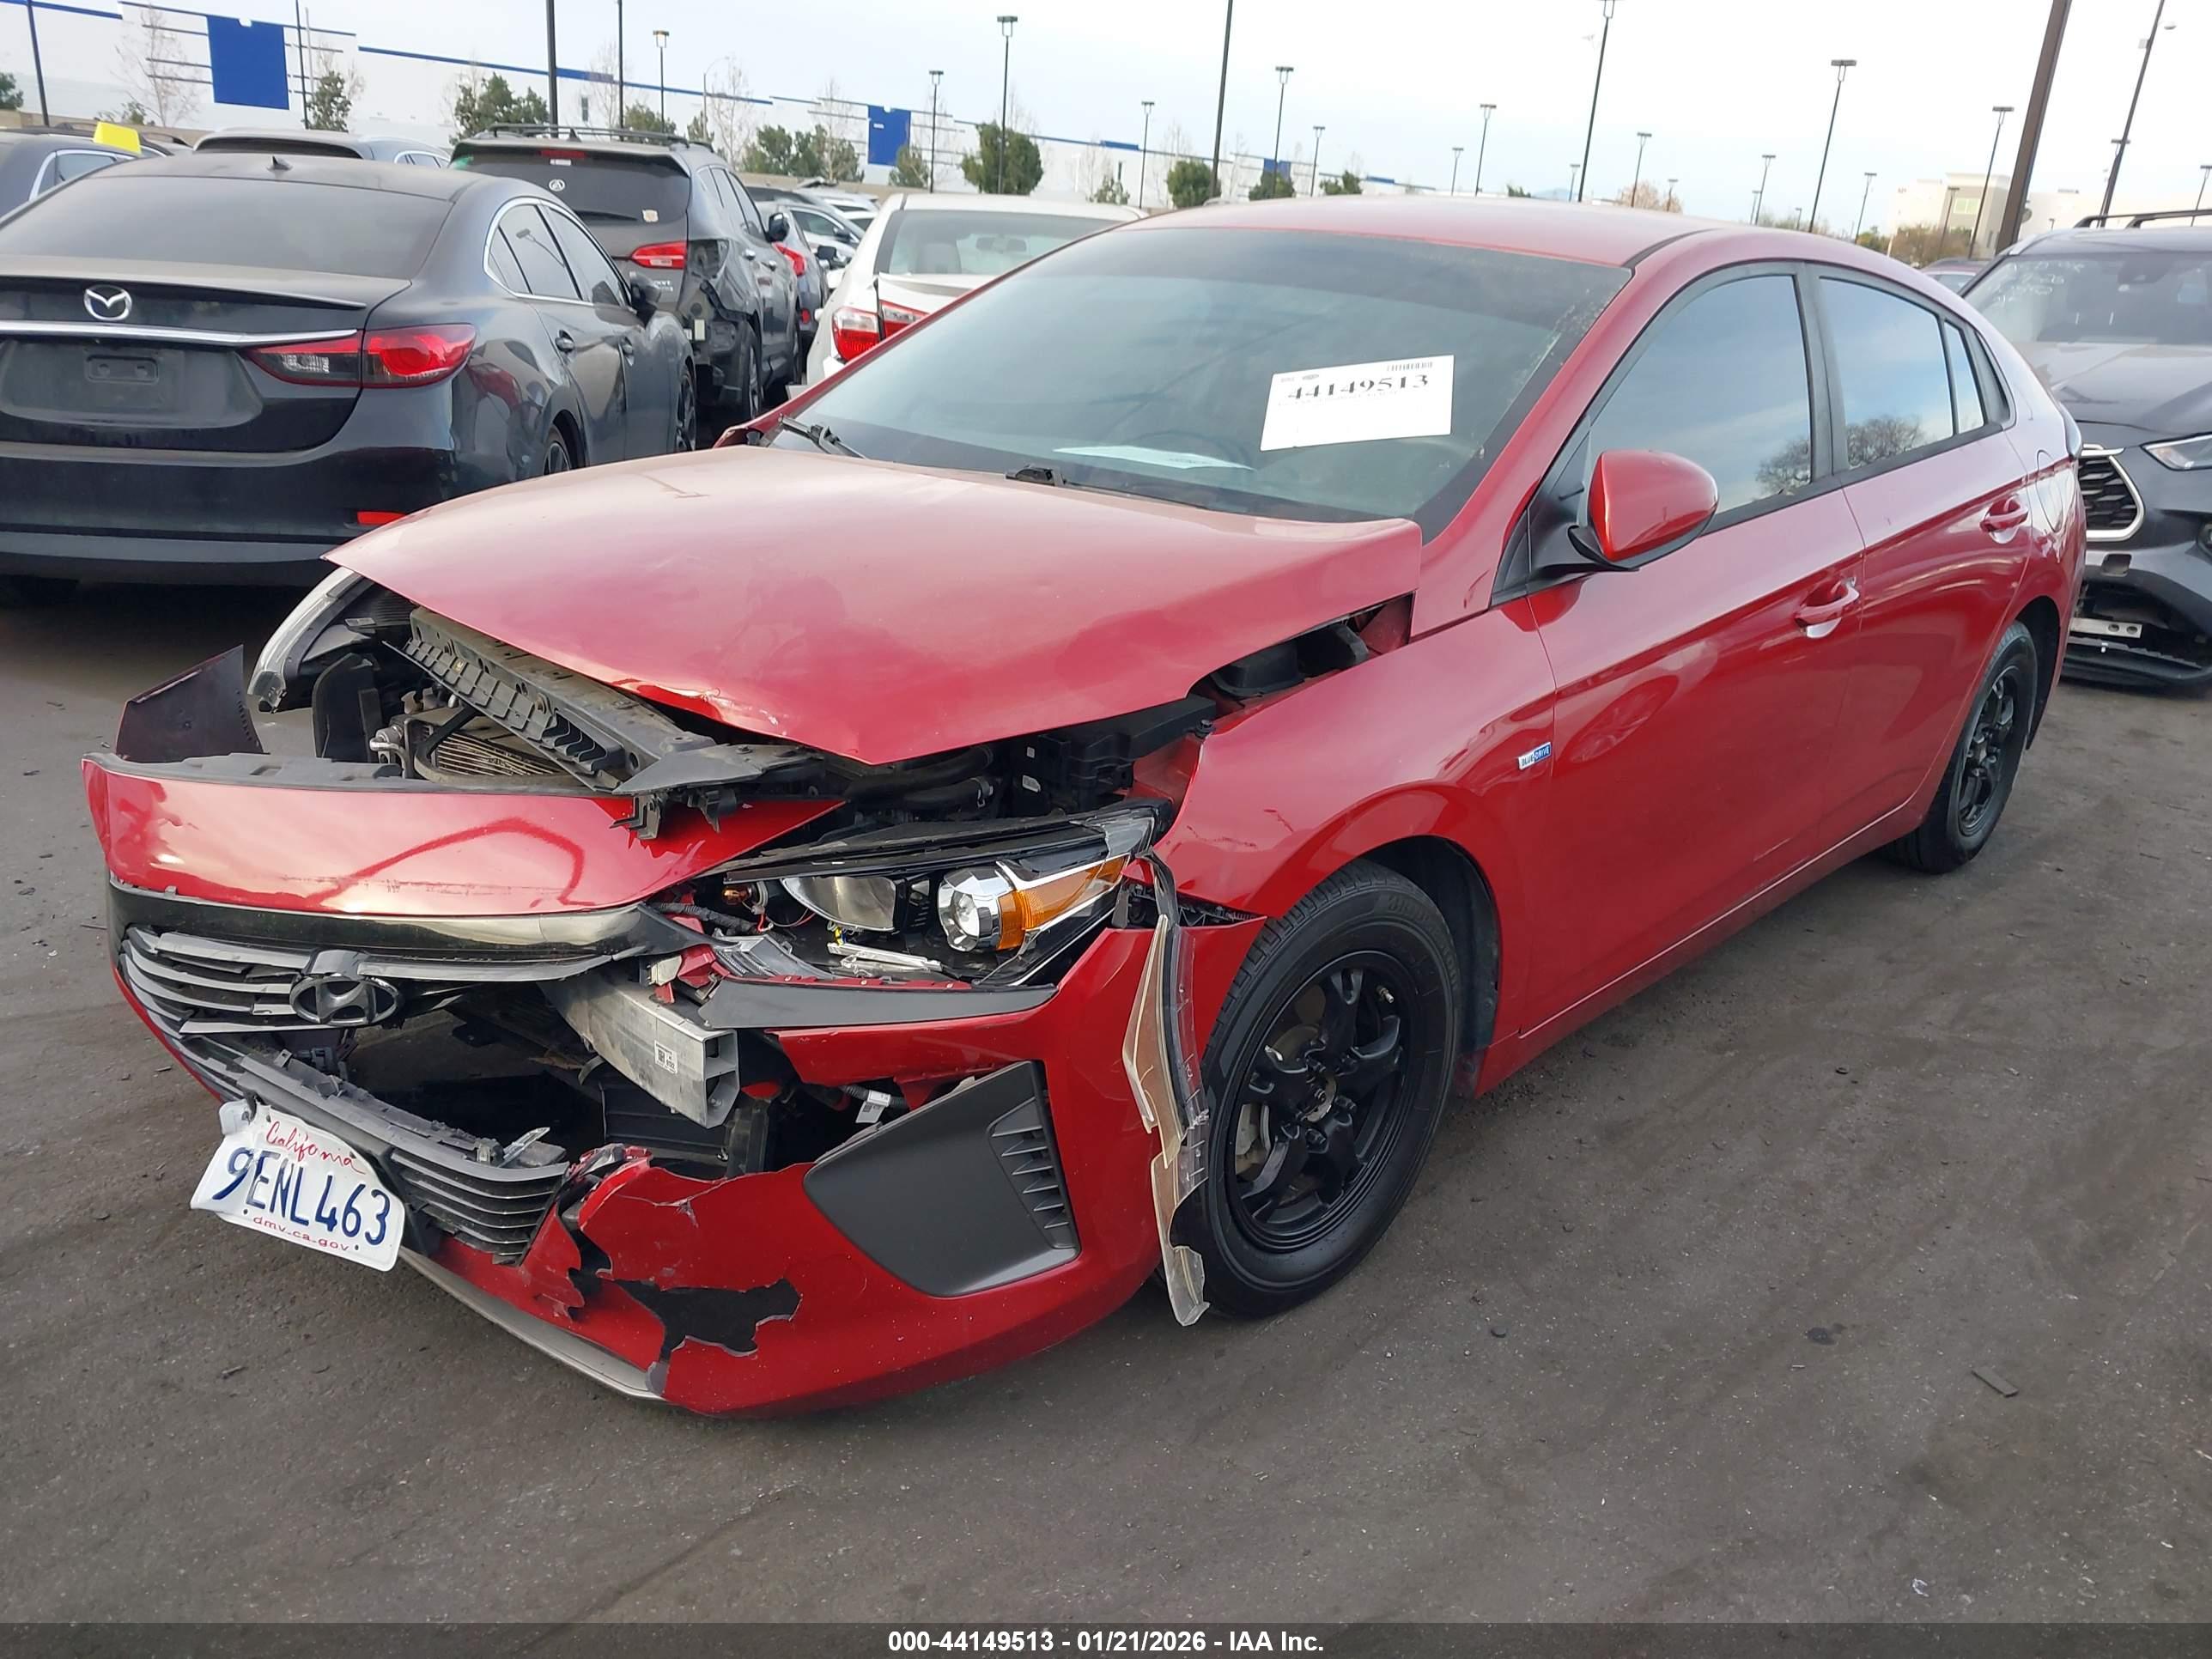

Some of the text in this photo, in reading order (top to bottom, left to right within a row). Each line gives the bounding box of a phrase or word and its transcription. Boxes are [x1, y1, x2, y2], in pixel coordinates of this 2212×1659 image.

[1287, 374, 1429, 400] 44149513
[265, 1120, 367, 1176] California
[212, 1146, 392, 1246] 9ENL463
[252, 1216, 350, 1252] dmv.ca.gov
